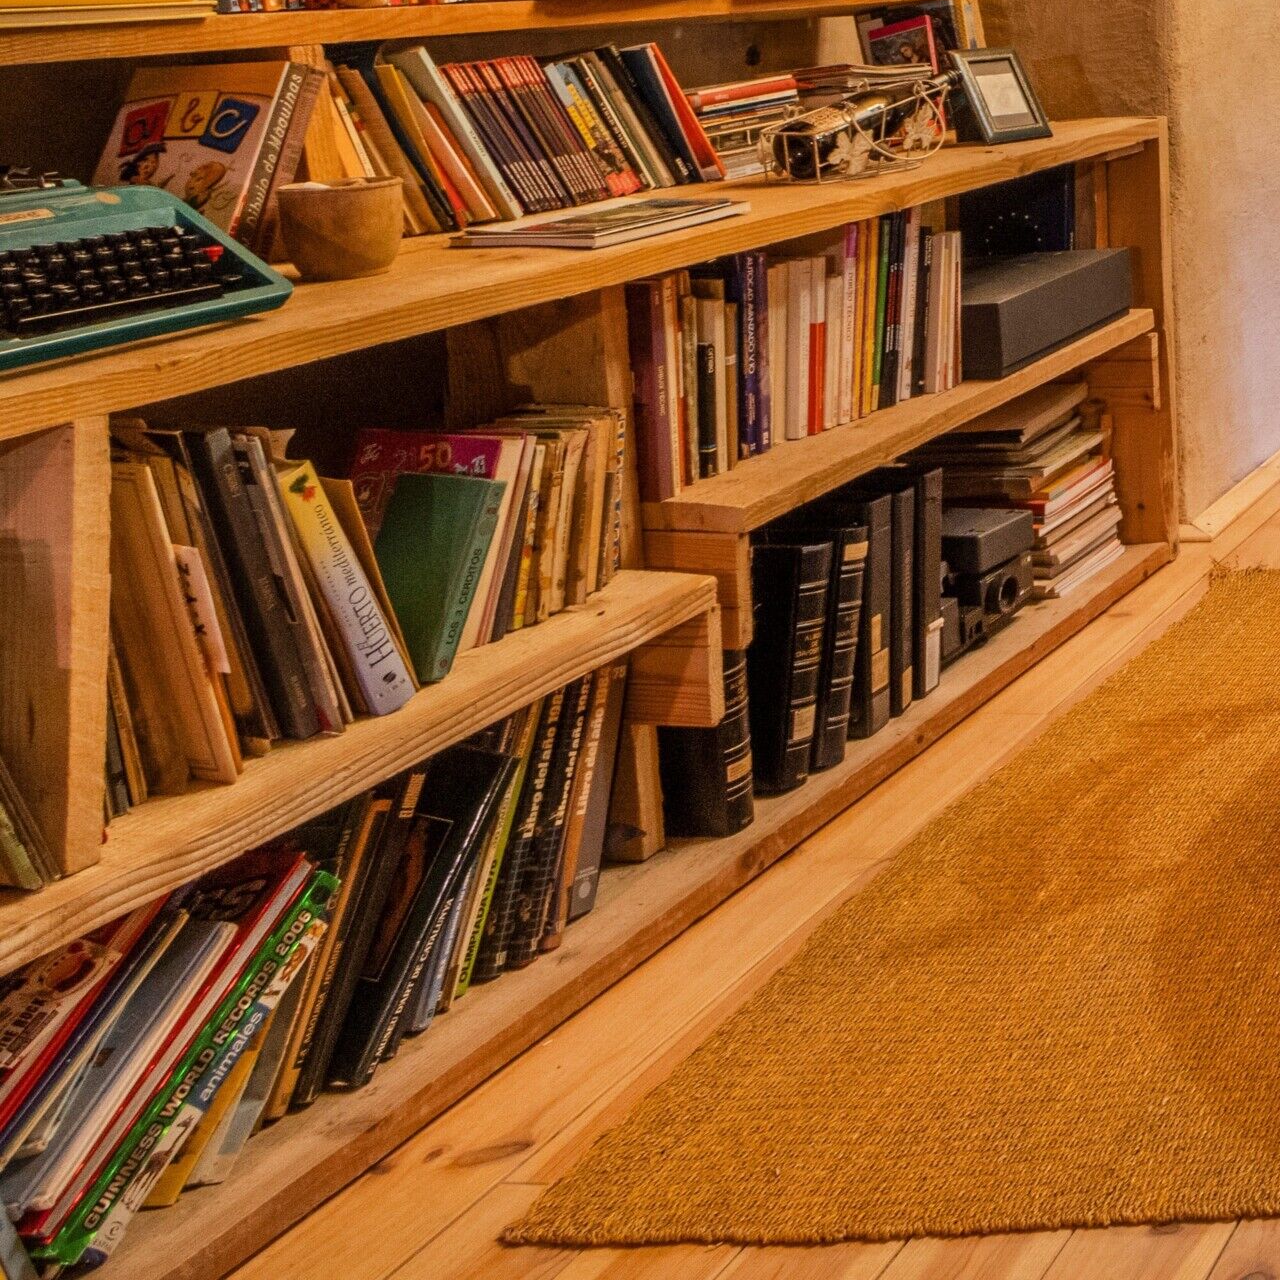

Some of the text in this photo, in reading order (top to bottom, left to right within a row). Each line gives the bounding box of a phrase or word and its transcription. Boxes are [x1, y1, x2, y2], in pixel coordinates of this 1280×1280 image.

[260, 151, 277, 173] de
[846, 271, 854, 301] DIBUJO
[419, 443, 452, 470] 50
[312, 503, 358, 586] mediterráneo
[444, 620, 460, 646] LOS
[457, 545, 483, 605] CERDITOS
[345, 584, 396, 669] HUERTO
[539, 725, 557, 761] año
[569, 715, 584, 749] año
[588, 707, 603, 740] año
[532, 761, 548, 791] del
[564, 750, 577, 779] del
[583, 740, 598, 768] del
[521, 790, 543, 840] Libro
[554, 778, 571, 828] Libro
[576, 769, 592, 816] Libro
[410, 962, 423, 981] DE
[419, 896, 454, 963] CATALUNYA
[457, 895, 487, 984] OLIMPIADA
[80, 907, 313, 1231] GUINNESS WORLD RECORDS 2006
[197, 1008, 264, 1102] animales
